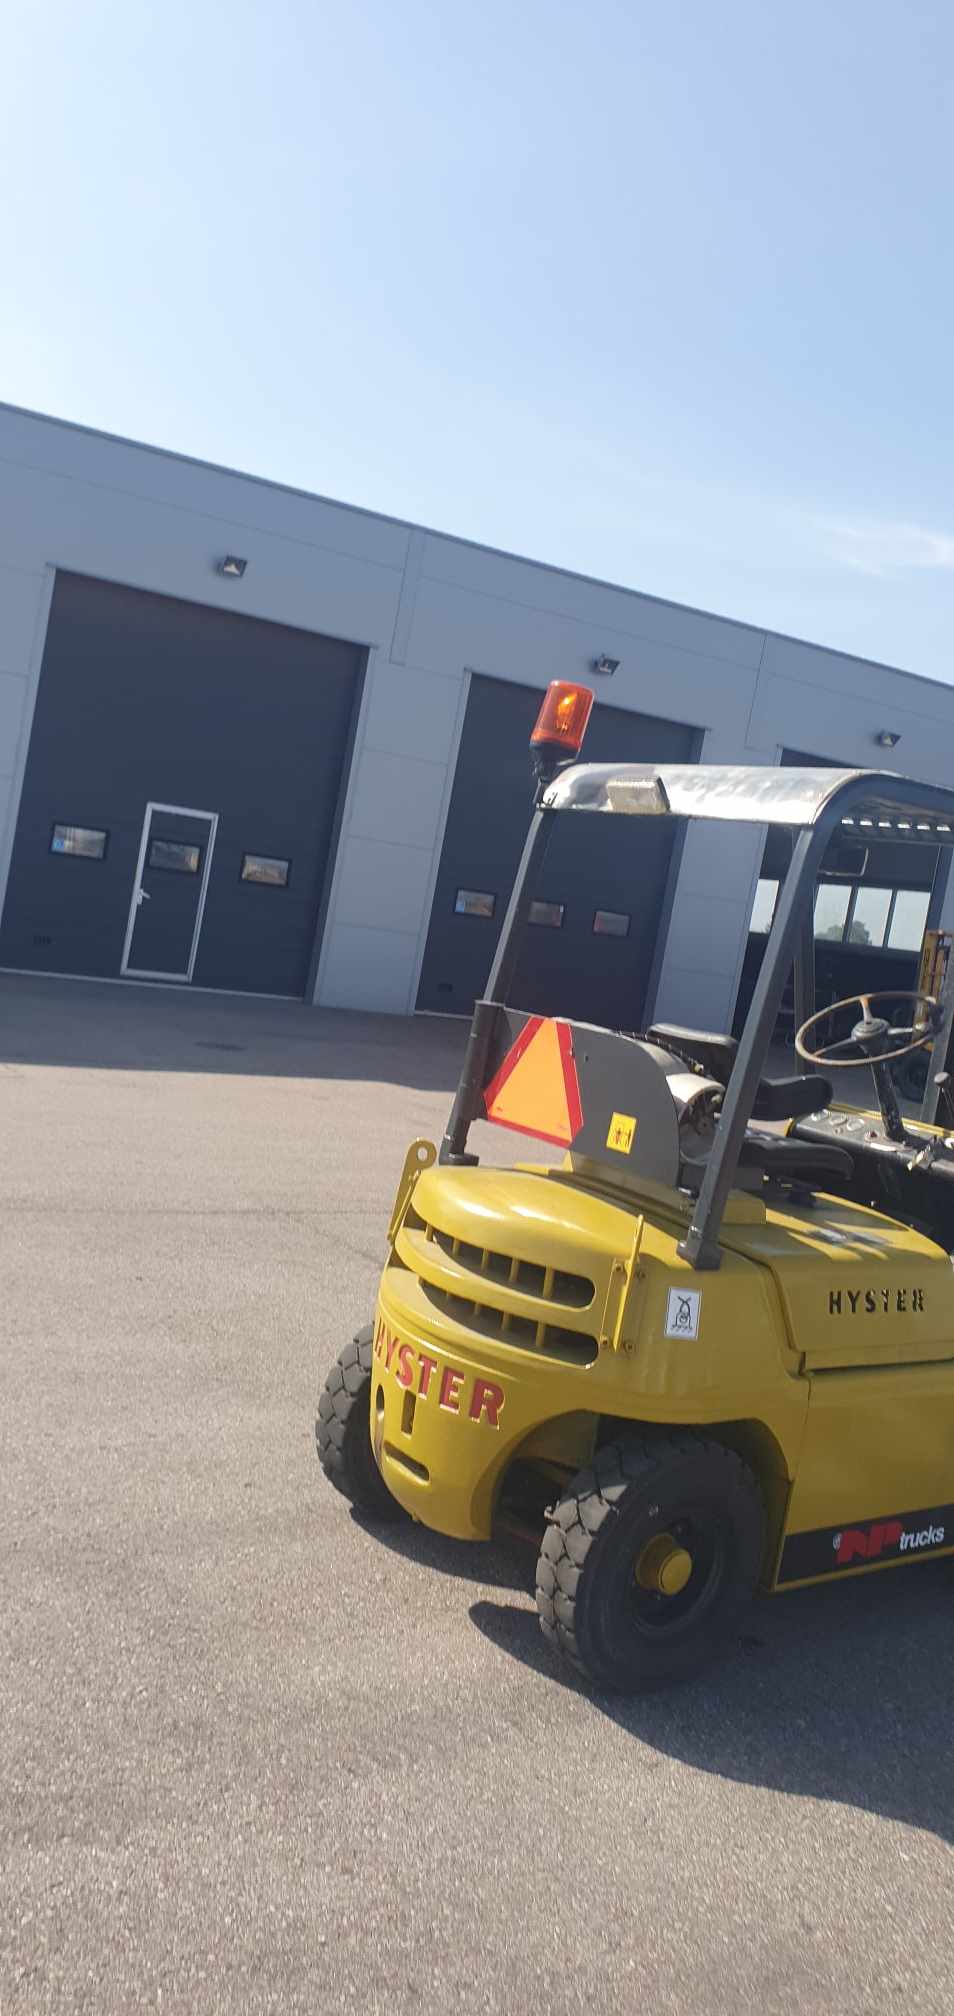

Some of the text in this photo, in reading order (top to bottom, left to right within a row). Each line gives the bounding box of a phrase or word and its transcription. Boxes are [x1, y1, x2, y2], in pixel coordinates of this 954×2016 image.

[829, 1288, 924, 1314] HYSTER
[375, 1317, 505, 1429] HYSTER
[900, 1526, 945, 1550] trucks
